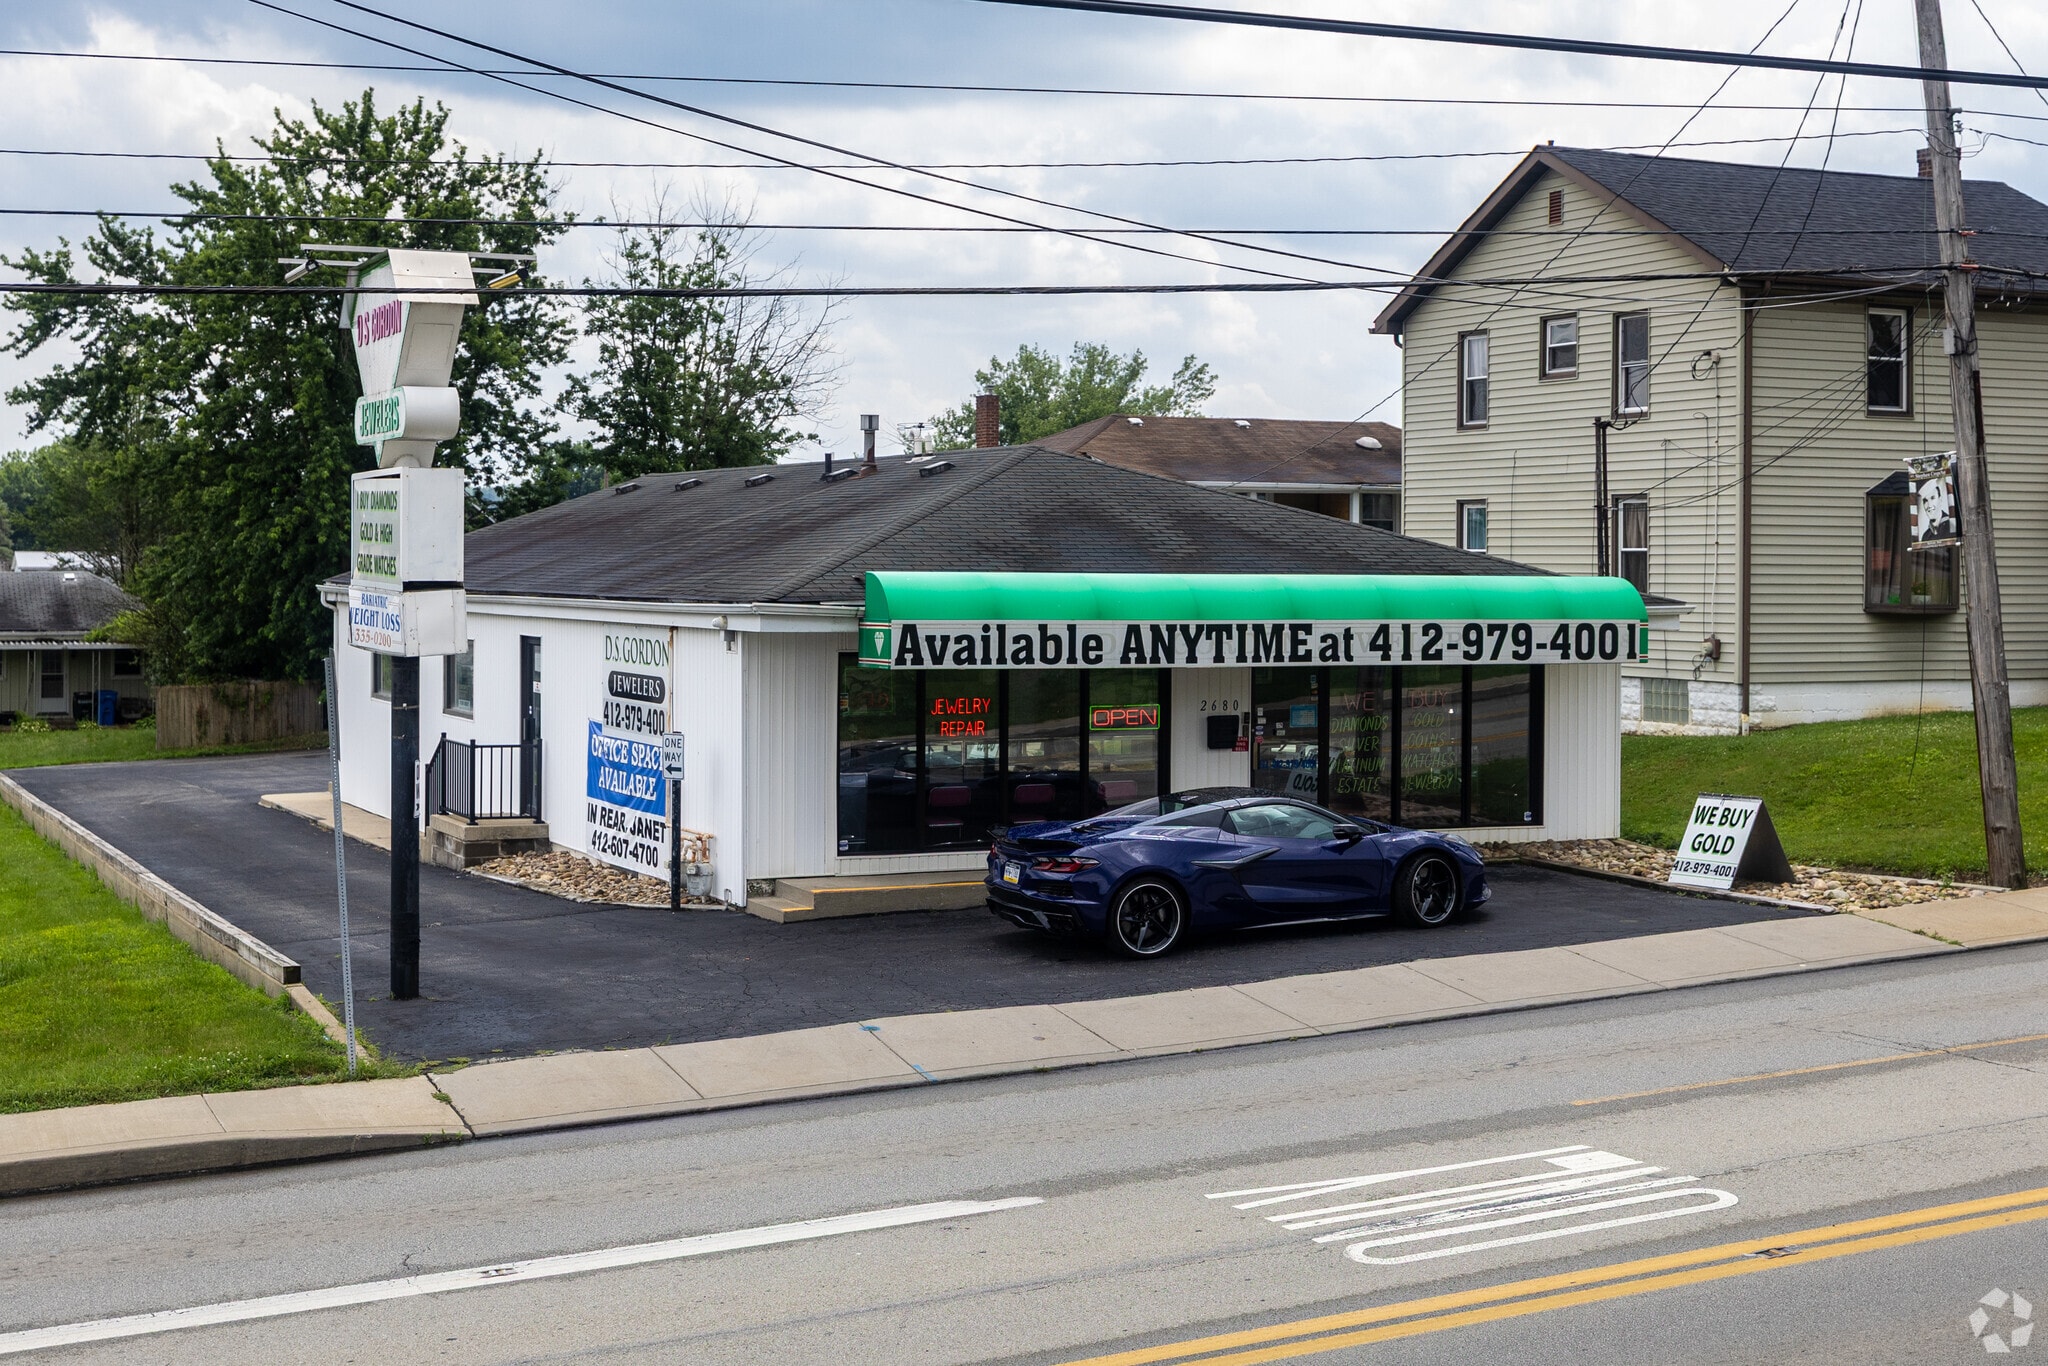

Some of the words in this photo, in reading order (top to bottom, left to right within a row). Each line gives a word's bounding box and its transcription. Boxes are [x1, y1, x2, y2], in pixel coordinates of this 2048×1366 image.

[371, 299, 402, 341] GORDON
[360, 396, 400, 437] JEWELERS
[360, 491, 370, 511] BUY
[370, 490, 398, 513] DIAMONDS
[359, 522, 373, 543] GOLD
[374, 523, 379, 543] &
[379, 523, 393, 544] HIGH
[357, 553, 373, 574] GRADE
[373, 554, 397, 577] WATCHES
[361, 593, 388, 609] BARIATRIC
[381, 612, 400, 633] LOSS
[622, 637, 669, 667] GORDON
[894, 624, 1104, 666] Available
[1120, 624, 1312, 665] ANYTIME
[1319, 626, 1354, 662] at
[1369, 623, 1638, 662] 412-979-4001
[612, 674, 660, 698] JEWELERS
[931, 697, 992, 716] JEWELRY
[1200, 699, 1239, 712] 2680
[1343, 691, 1376, 712] WE
[1409, 689, 1449, 709] BUY
[603, 701, 665, 736] 412-979-400
[1092, 708, 1158, 727] OPEN
[1330, 714, 1389, 734] DIAMONDS
[1413, 712, 1445, 728] GOLD
[939, 720, 985, 737] REPAIR
[591, 734, 629, 763] OFFICE
[664, 737, 682, 749] ONE
[1338, 736, 1380, 753] SILVER
[1406, 732, 1448, 749] COINS
[664, 751, 681, 762] WAY
[1329, 756, 1387, 775] PLATINUM
[1401, 752, 1456, 768] WATCHES
[598, 766, 657, 801] AVAILABLE
[1336, 776, 1382, 794] ESTATE
[587, 802, 598, 824] IN
[629, 815, 667, 843] JANET
[1694, 805, 1719, 826] WE
[1718, 807, 1754, 829] BUY
[591, 829, 659, 868] 412-607-4700
[1690, 833, 1735, 856] GOLD
[1673, 860, 1737, 878] 412-979-4001
